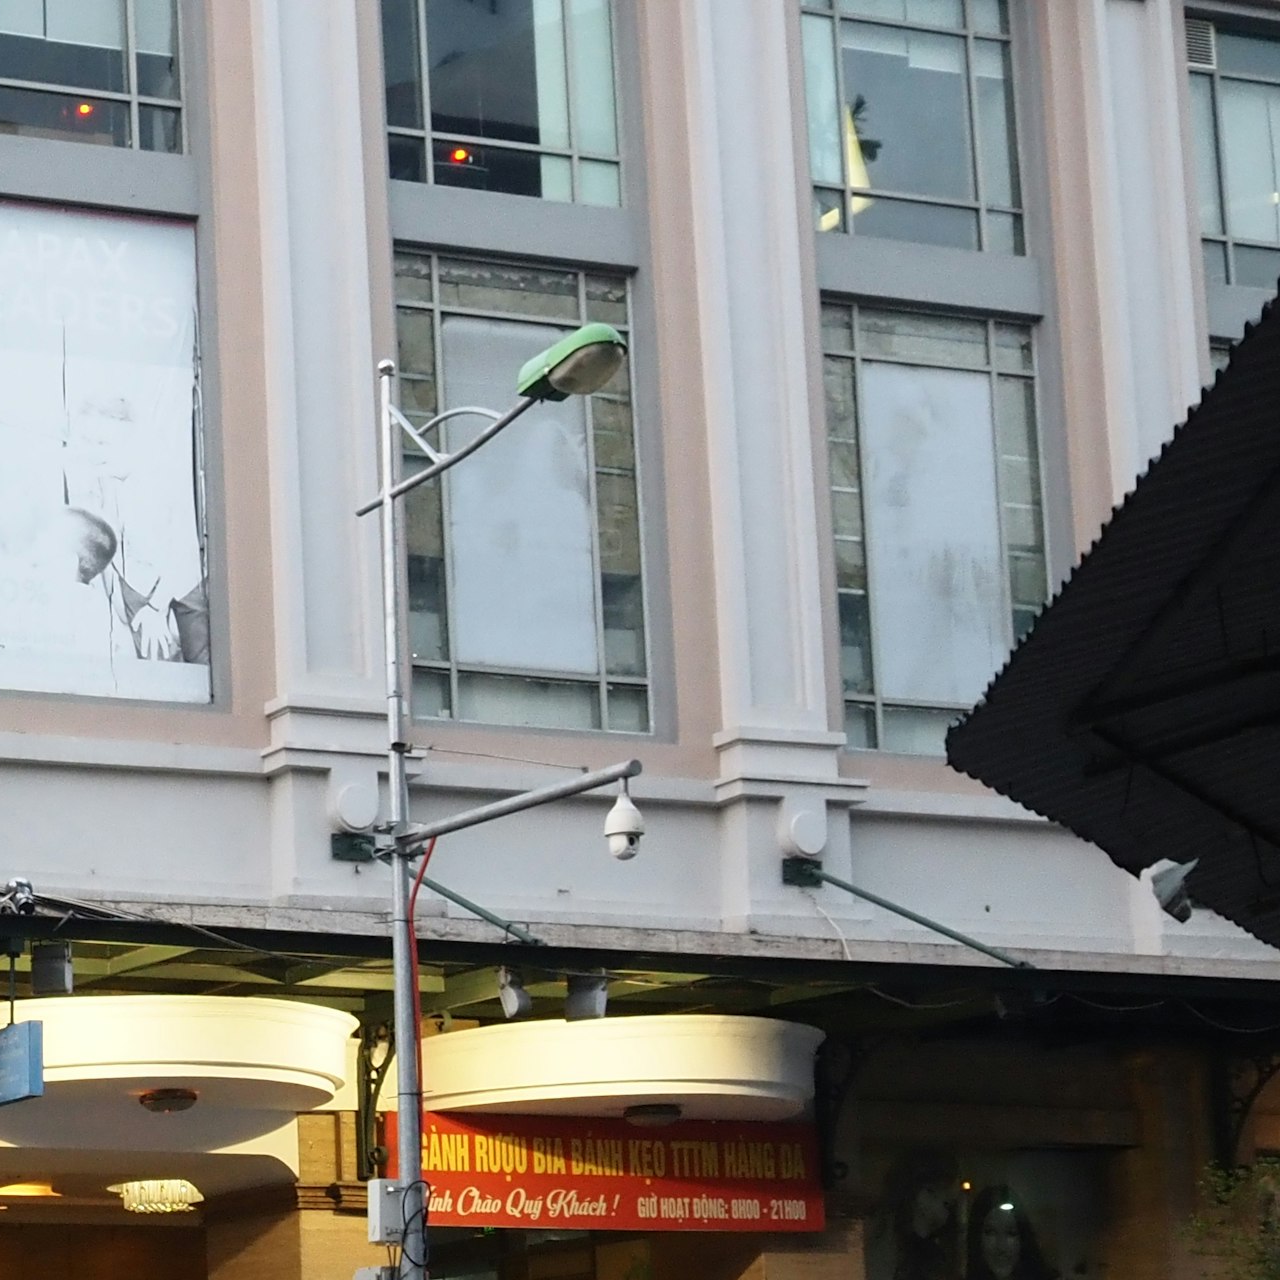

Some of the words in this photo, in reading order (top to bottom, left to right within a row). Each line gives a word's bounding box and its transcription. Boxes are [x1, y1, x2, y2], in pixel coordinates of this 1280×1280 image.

[0, 229, 129, 281] APAX
[421, 1125, 470, 1172] GÀNH
[474, 1131, 528, 1182] RƯỢU
[533, 1137, 567, 1175] BIA
[571, 1132, 624, 1177] BÁNH
[628, 1139, 666, 1186] KẸO
[669, 1140, 719, 1178] TTTM
[723, 1135, 776, 1179] HÀNG
[426, 1185, 454, 1213] ính
[456, 1186, 502, 1216] Chào
[505, 1187, 543, 1221] Quý
[546, 1188, 608, 1218] Khách
[637, 1192, 658, 1219] GIỜ
[660, 1197, 690, 1223] HOẠT
[731, 1199, 761, 1220] 8H00
[770, 1199, 807, 1221] 21H00
